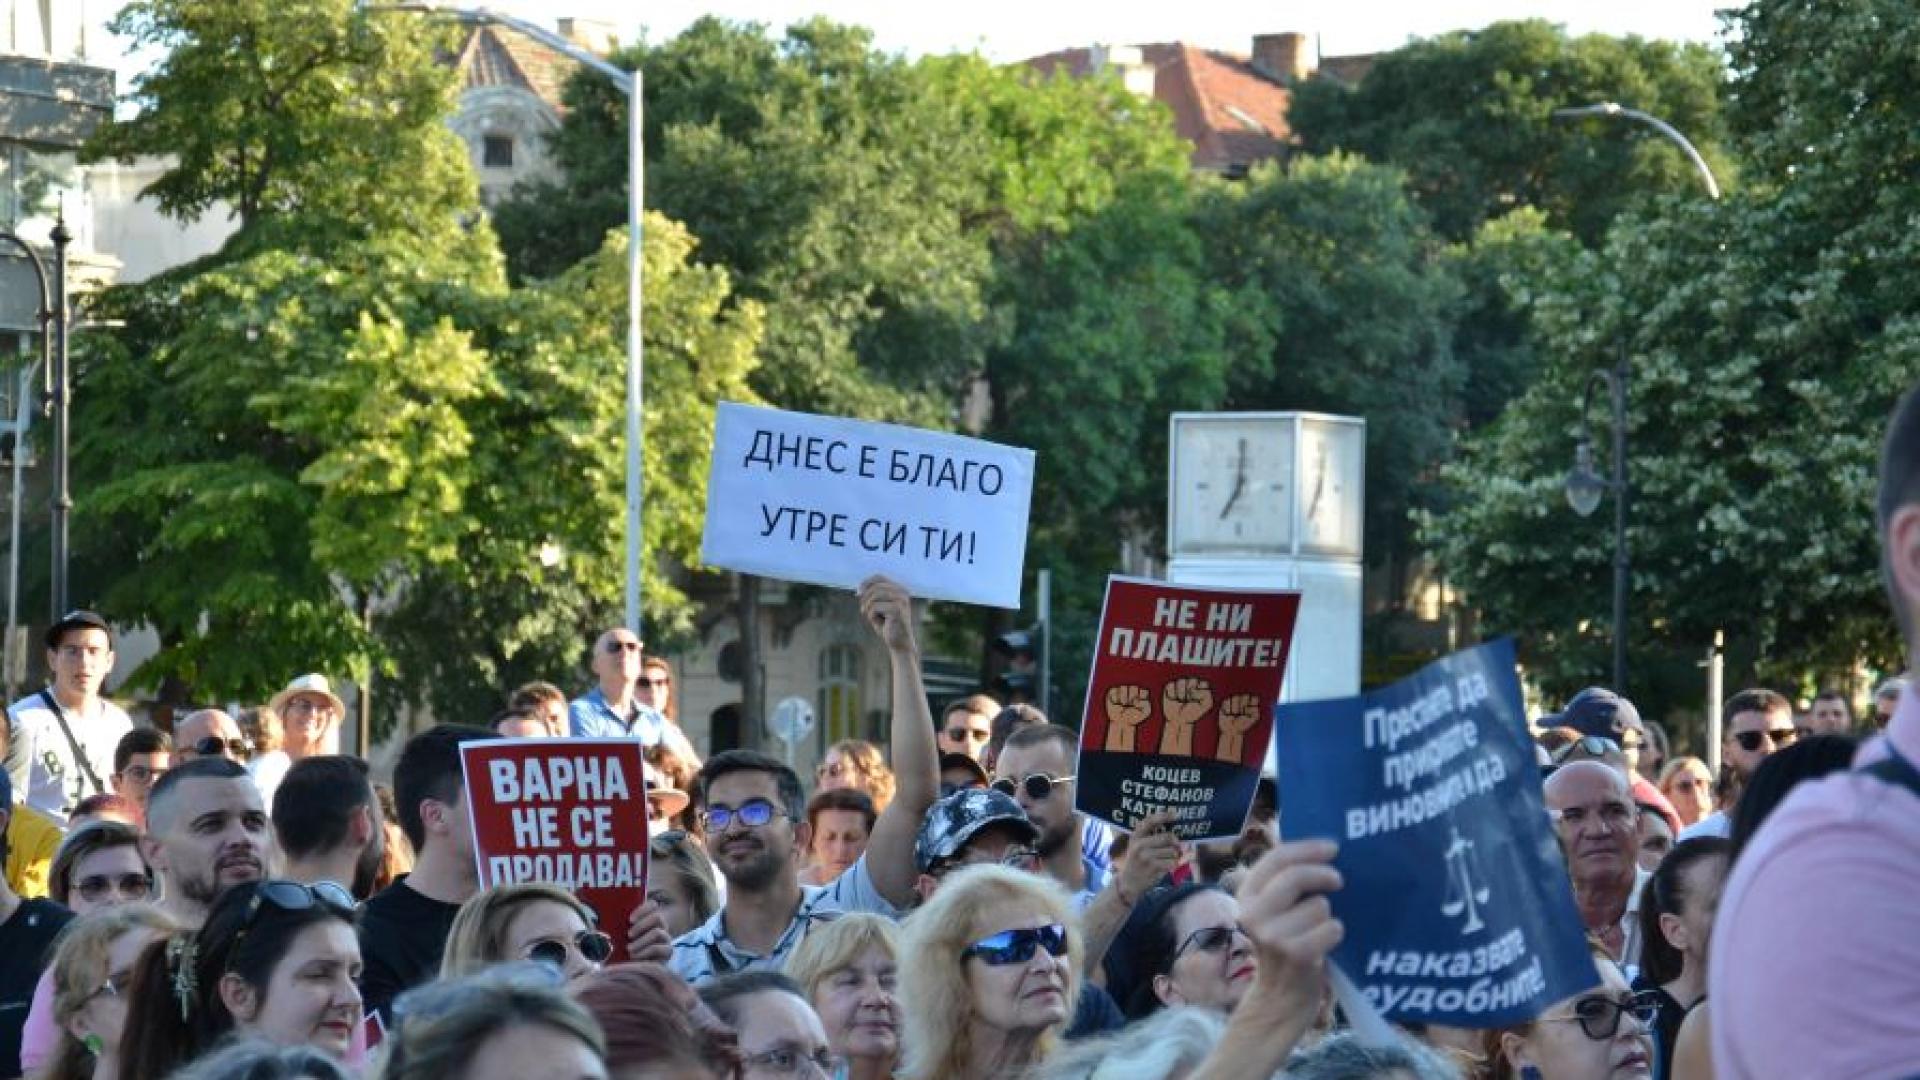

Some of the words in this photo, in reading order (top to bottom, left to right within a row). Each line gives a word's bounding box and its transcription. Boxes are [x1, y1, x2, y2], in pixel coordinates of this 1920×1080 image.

[744, 430, 849, 472] ДНЕС
[859, 445, 878, 478] Е
[889, 450, 1003, 495] БЛАГО
[761, 504, 848, 546] УТРЕ
[859, 519, 907, 555] СИ
[920, 526, 976, 564] ТИ!
[1154, 598, 1198, 629] НЕ
[1206, 602, 1253, 632] НИ
[1109, 627, 1281, 667] ПЛАШИТЕ!
[489, 756, 629, 803] ВАРНА
[1122, 780, 1214, 802] СТЕФАНОВ
[1142, 765, 1200, 784] КОЦЕВ
[512, 806, 561, 848] НЕ
[570, 805, 616, 847] СЕ
[1122, 797, 1207, 819] КАТЕИЕВ
[489, 853, 642, 888] ПРОДАВА!
